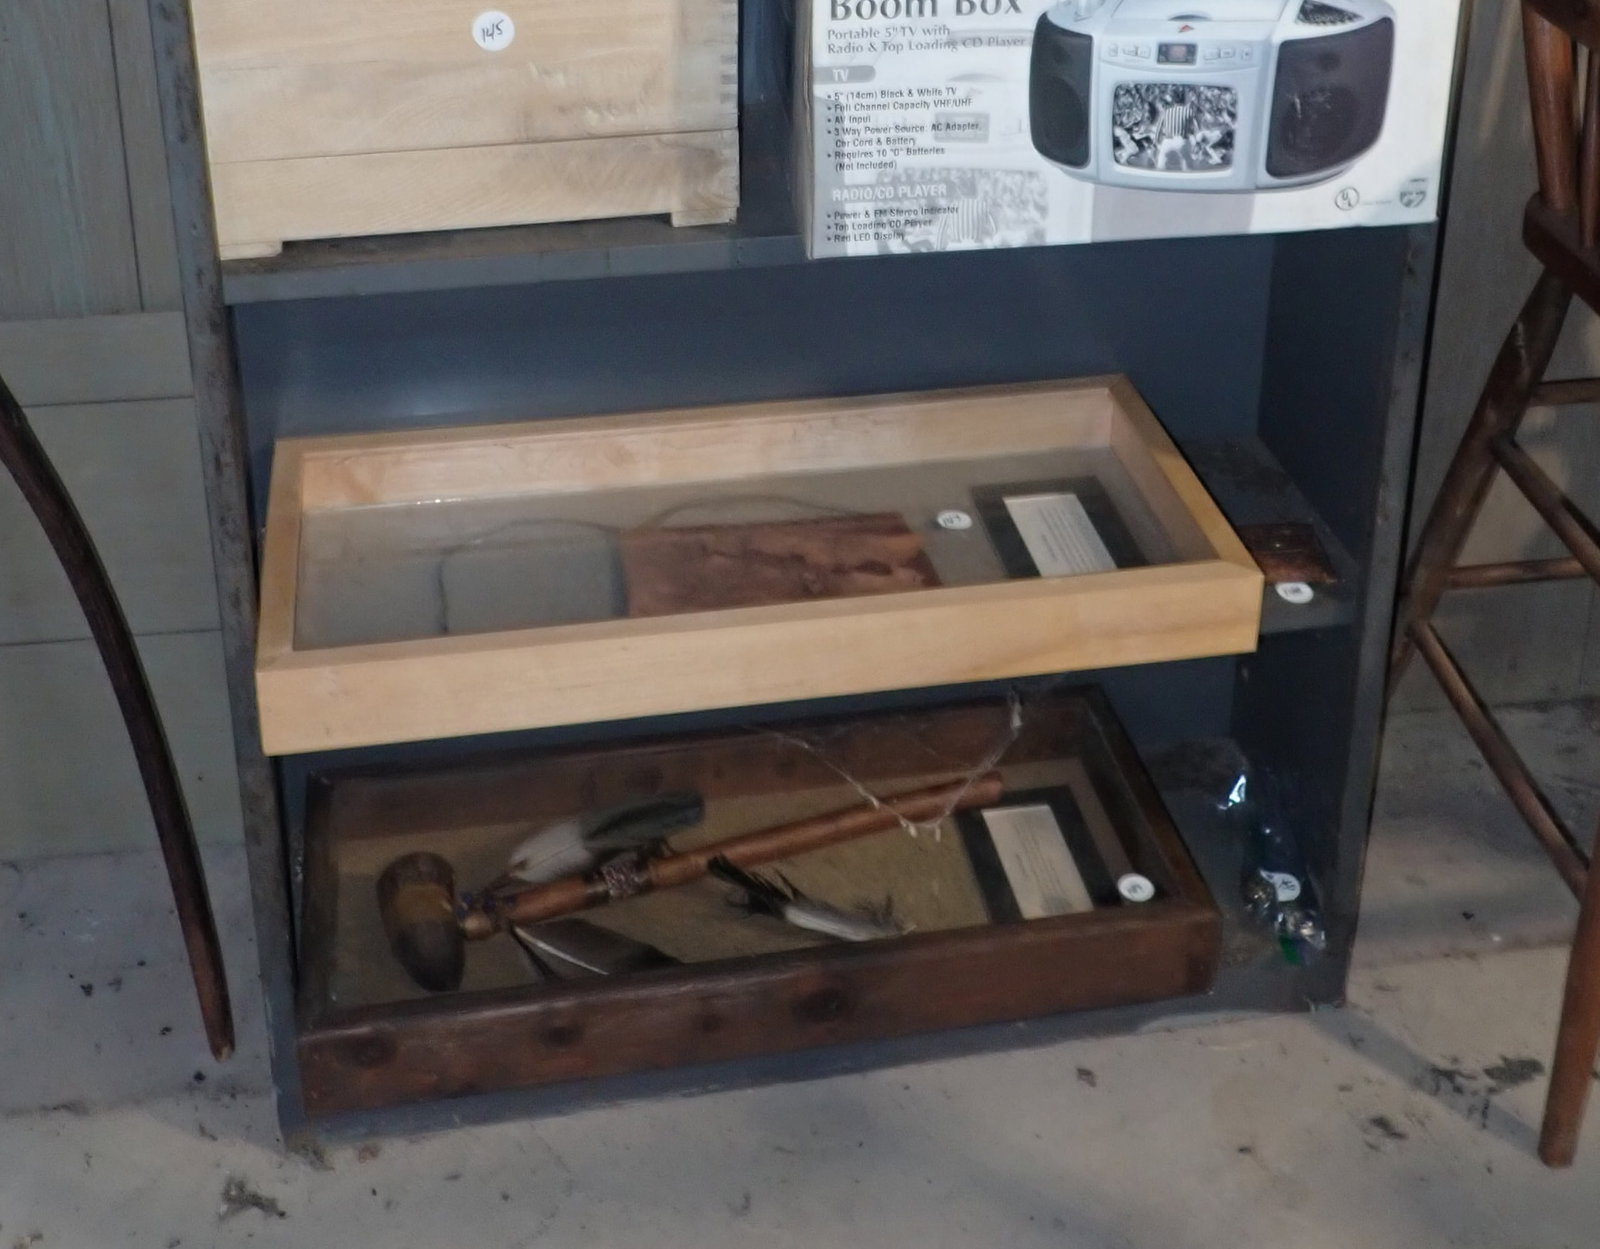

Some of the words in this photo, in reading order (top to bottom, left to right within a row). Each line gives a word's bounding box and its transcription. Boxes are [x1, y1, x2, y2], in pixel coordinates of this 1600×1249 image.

[482, 19, 504, 43] 145
[827, 26, 880, 41] Portable
[900, 26, 916, 37] TV
[922, 24, 951, 37] with
[827, 41, 864, 55] Radio
[867, 42, 877, 53] &
[882, 40, 905, 55] Top
[908, 38, 959, 53] Loading
[962, 36, 983, 49] CD
[987, 35, 1026, 49] Player
[832, 68, 849, 82] TV
[846, 90, 878, 102] (14cm)
[880, 89, 904, 100] Black
[907, 88, 914, 98] &
[917, 88, 943, 98] White
[946, 86, 957, 96] TV
[834, 102, 851, 113] Full
[854, 101, 890, 113] Channel
[893, 99, 931, 111] Capacity
[933, 98, 974, 109] VHF/UHF
[849, 114, 871, 125] Input
[842, 126, 861, 137] Way
[865, 125, 891, 136] Power
[931, 122, 943, 132] AC
[852, 137, 874, 148] Cord
[876, 136, 883, 146] &
[885, 135, 917, 147] Battery
[834, 150, 874, 161] Requires
[906, 146, 945, 156] Batteries
[835, 161, 853, 172] (Not
[856, 159, 898, 171] Included)
[832, 186, 894, 201] RADIO/CD
[899, 183, 947, 198] PLAYER
[834, 210, 861, 221] Power
[851, 220, 887, 231] Loading
[889, 219, 902, 229] CD
[853, 232, 871, 242] LED
